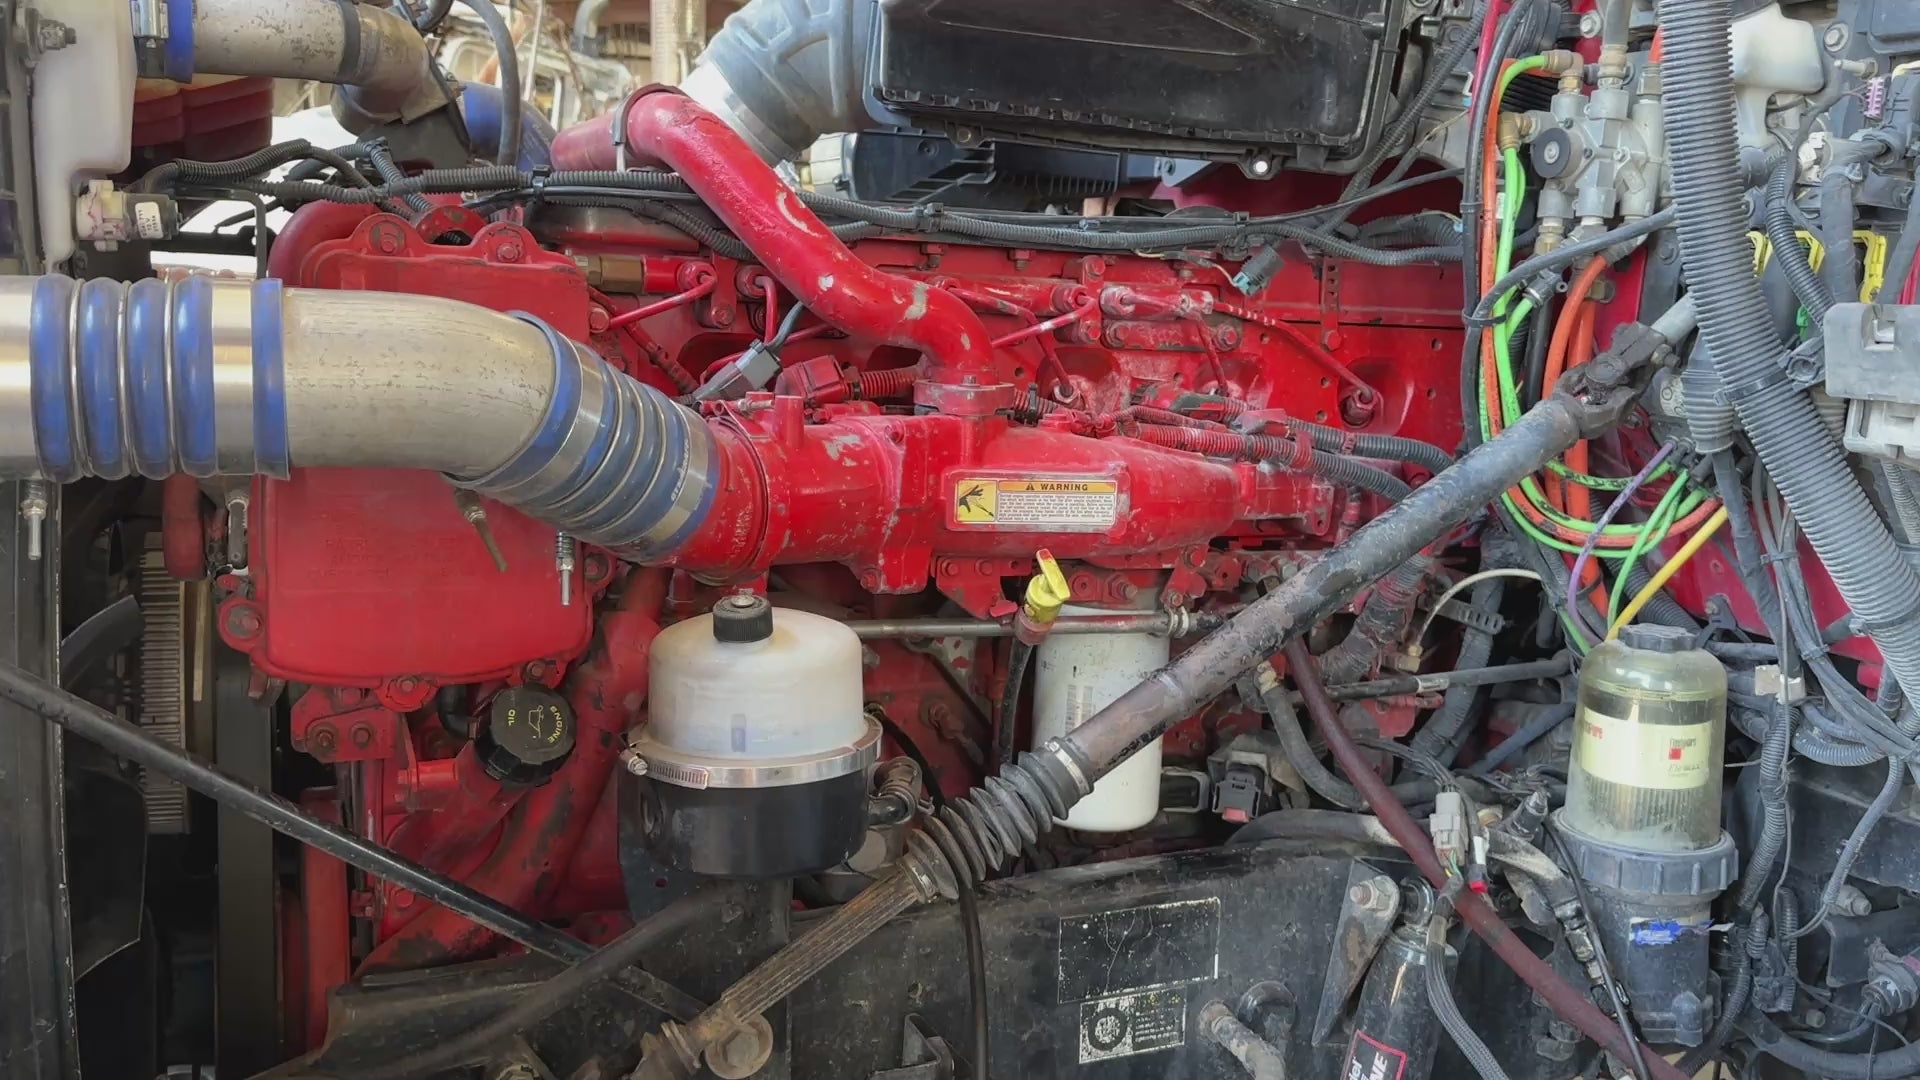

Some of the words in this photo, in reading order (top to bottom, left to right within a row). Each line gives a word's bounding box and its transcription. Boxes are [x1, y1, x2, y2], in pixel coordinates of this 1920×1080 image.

[1040, 483, 1088, 491] WARNING
[507, 709, 516, 726] OIL
[547, 705, 563, 744] ENGINE
